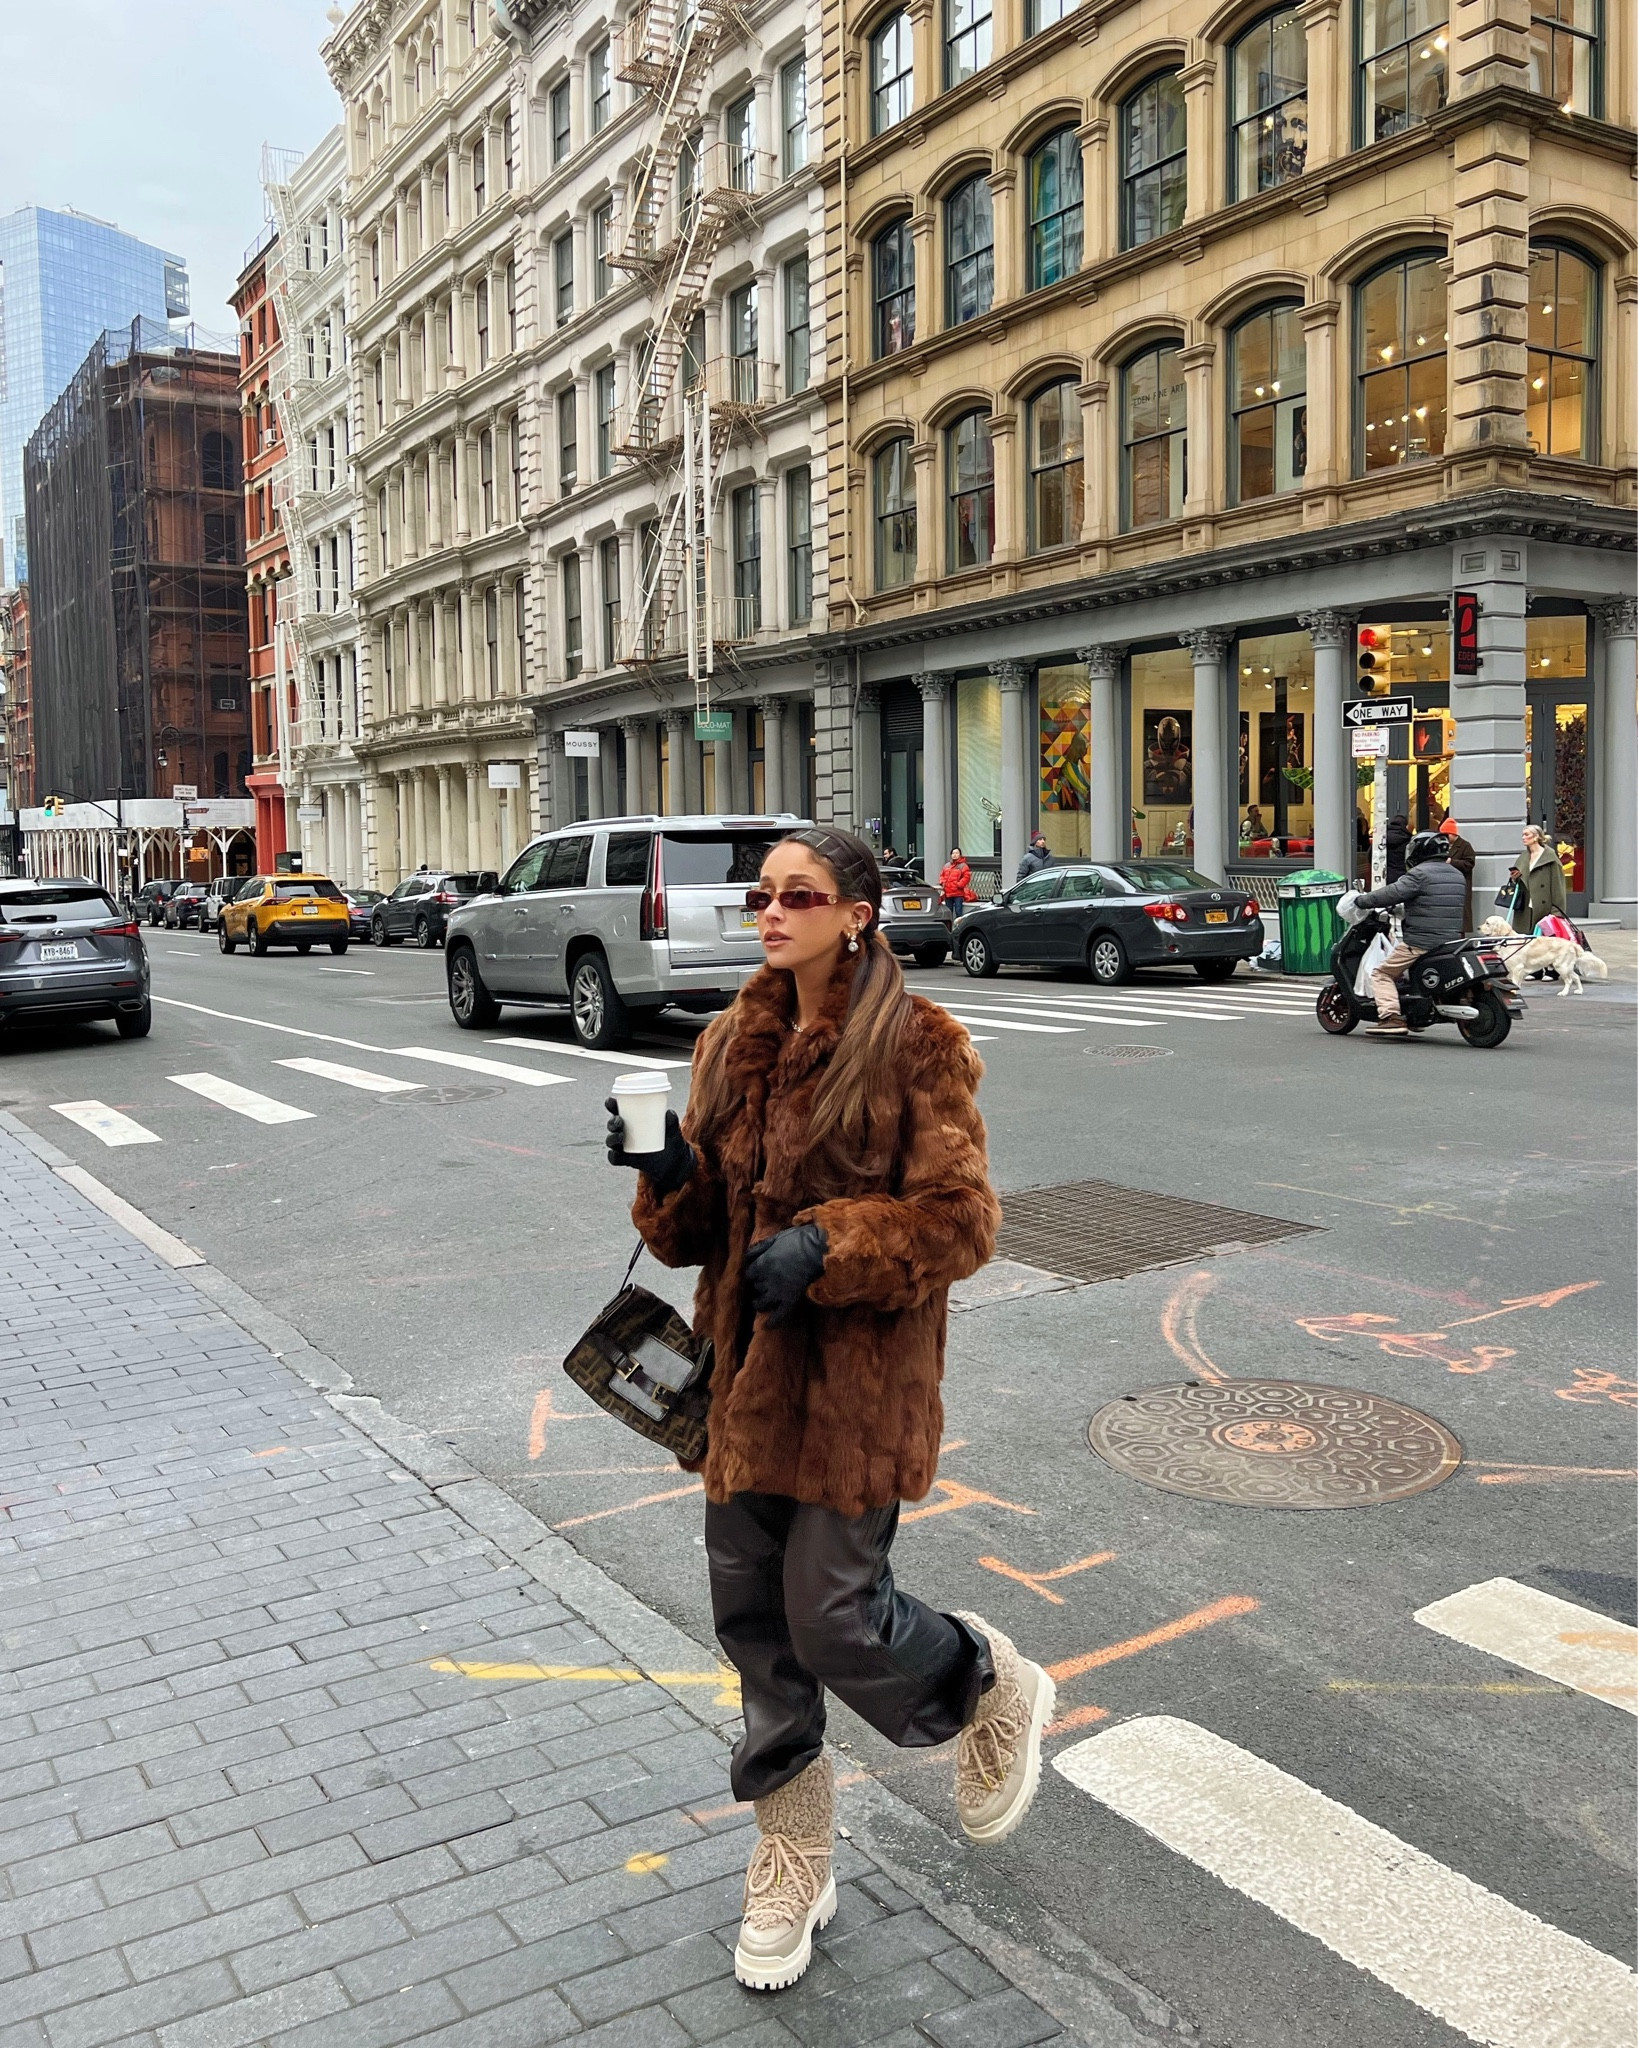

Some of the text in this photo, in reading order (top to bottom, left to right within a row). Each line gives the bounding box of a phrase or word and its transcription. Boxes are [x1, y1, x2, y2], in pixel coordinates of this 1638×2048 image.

[1133, 394, 1150, 406] EDEN
[1171, 383, 1185, 394] ART
[1458, 651, 1475, 660] EDEN
[1353, 706, 1403, 719] ONE WAY
[1444, 976, 1464, 989] UFO
